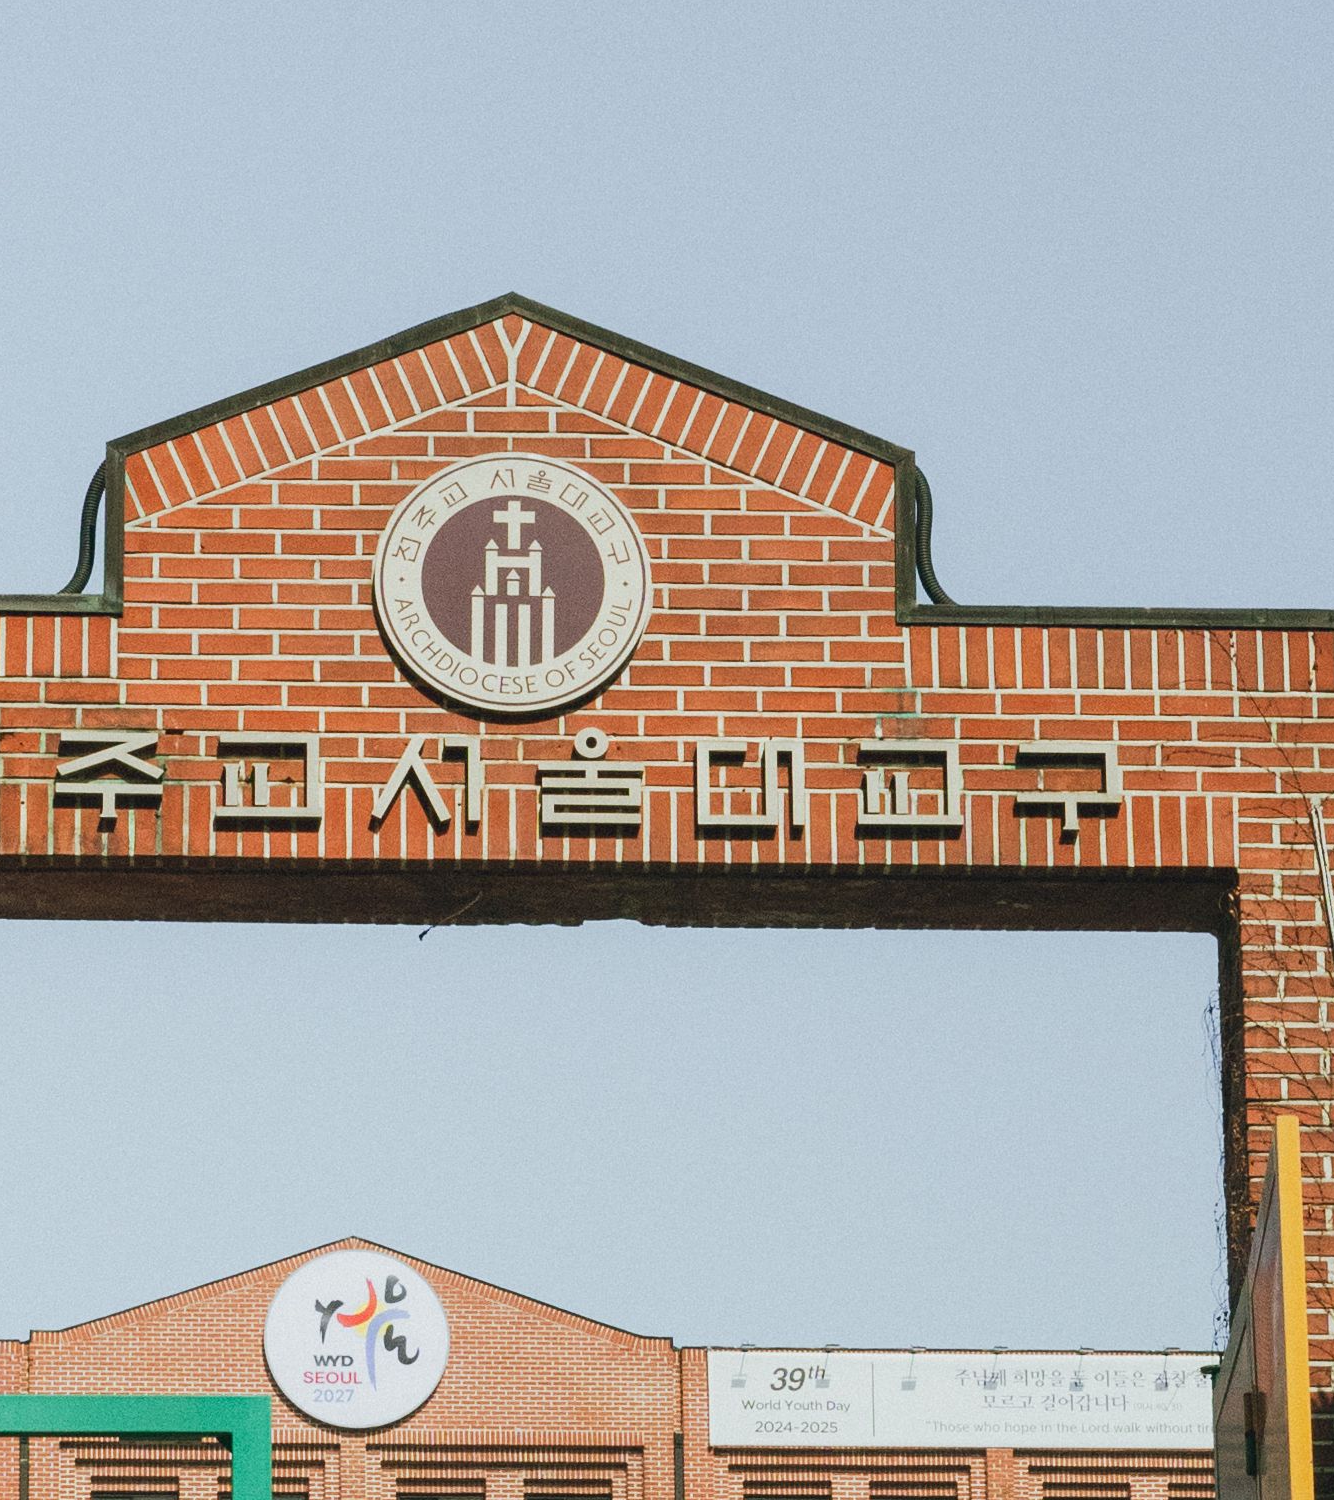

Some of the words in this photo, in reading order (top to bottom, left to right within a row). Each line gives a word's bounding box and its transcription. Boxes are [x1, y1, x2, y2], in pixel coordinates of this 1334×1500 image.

[392, 481, 468, 562] 천주교
[490, 468, 631, 565] 서울대교구
[394, 598, 539, 695] ARCHDIOCESE
[544, 661, 577, 689] OF
[578, 598, 633, 670] SEOUL
[313, 1354, 354, 1367] WYD
[303, 1371, 362, 1384] SEOUL
[770, 1365, 826, 1391] 39th
[1014, 1369, 1065, 1387] 희망을
[1094, 1370, 1146, 1388] 이들은
[313, 1389, 354, 1403] 2027
[981, 1395, 1035, 1409] 모르고
[1041, 1394, 1129, 1412] 걸어갑니다
[741, 1400, 781, 1411] World
[785, 1400, 823, 1411] Youth
[826, 1400, 851, 1412] Day
[754, 1421, 838, 1433] 2024-2025
[973, 1421, 1001, 1432] who
[1004, 1421, 1035, 1435] hope
[1041, 1421, 1052, 1432] in
[1057, 1422, 1077, 1433] the
[1081, 1422, 1110, 1433] Lord
[1113, 1422, 1141, 1433] walk
[1146, 1422, 1193, 1433] without
